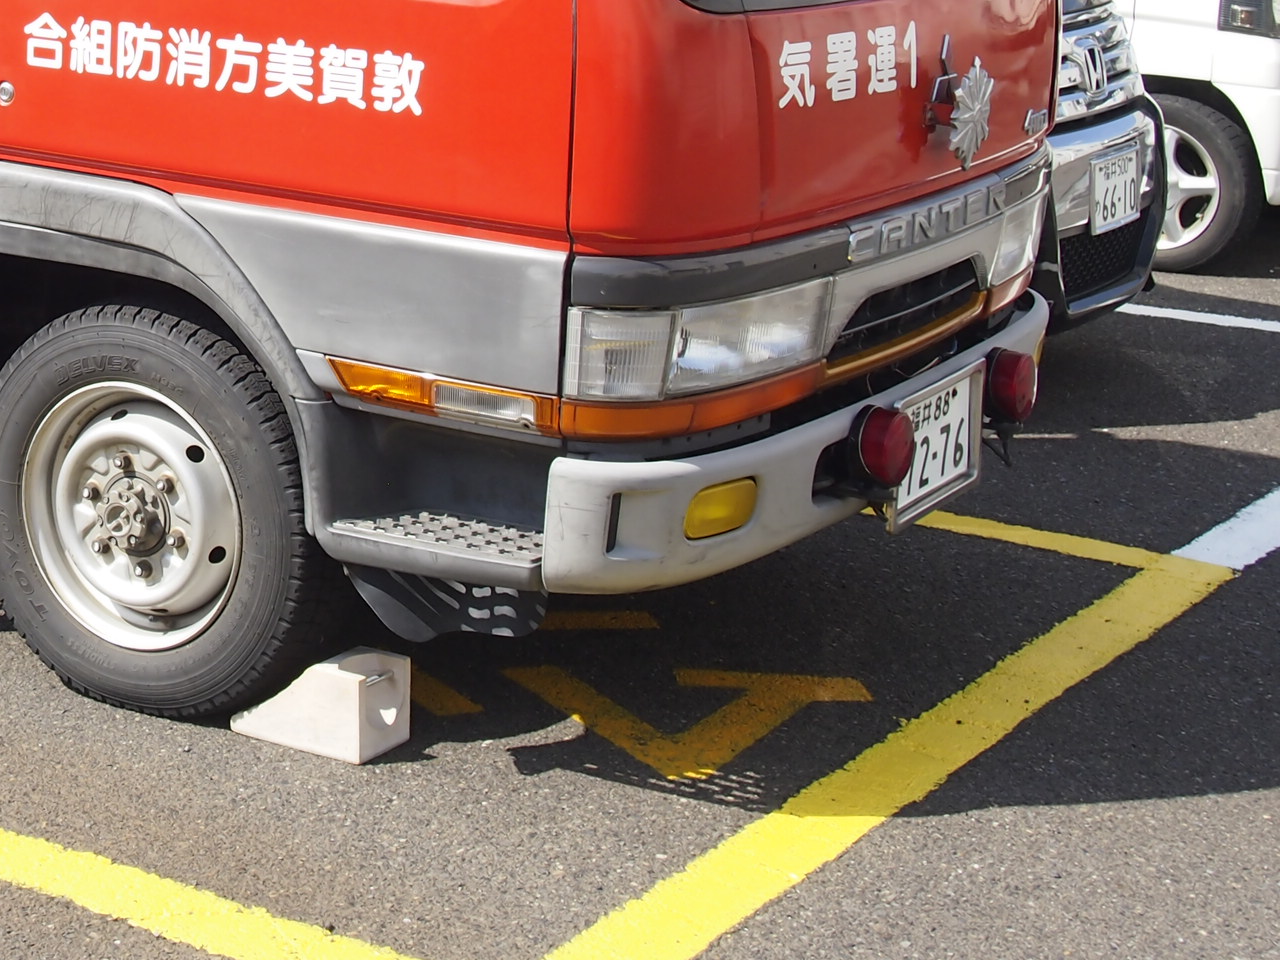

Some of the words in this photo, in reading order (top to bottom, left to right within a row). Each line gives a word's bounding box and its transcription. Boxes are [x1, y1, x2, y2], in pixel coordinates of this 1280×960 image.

[23, 11, 425, 116] 合組防消方美賀敦
[778, 20, 918, 109] 気署運1
[848, 182, 1007, 262] CANTER
[54, 354, 141, 387] DELVEX
